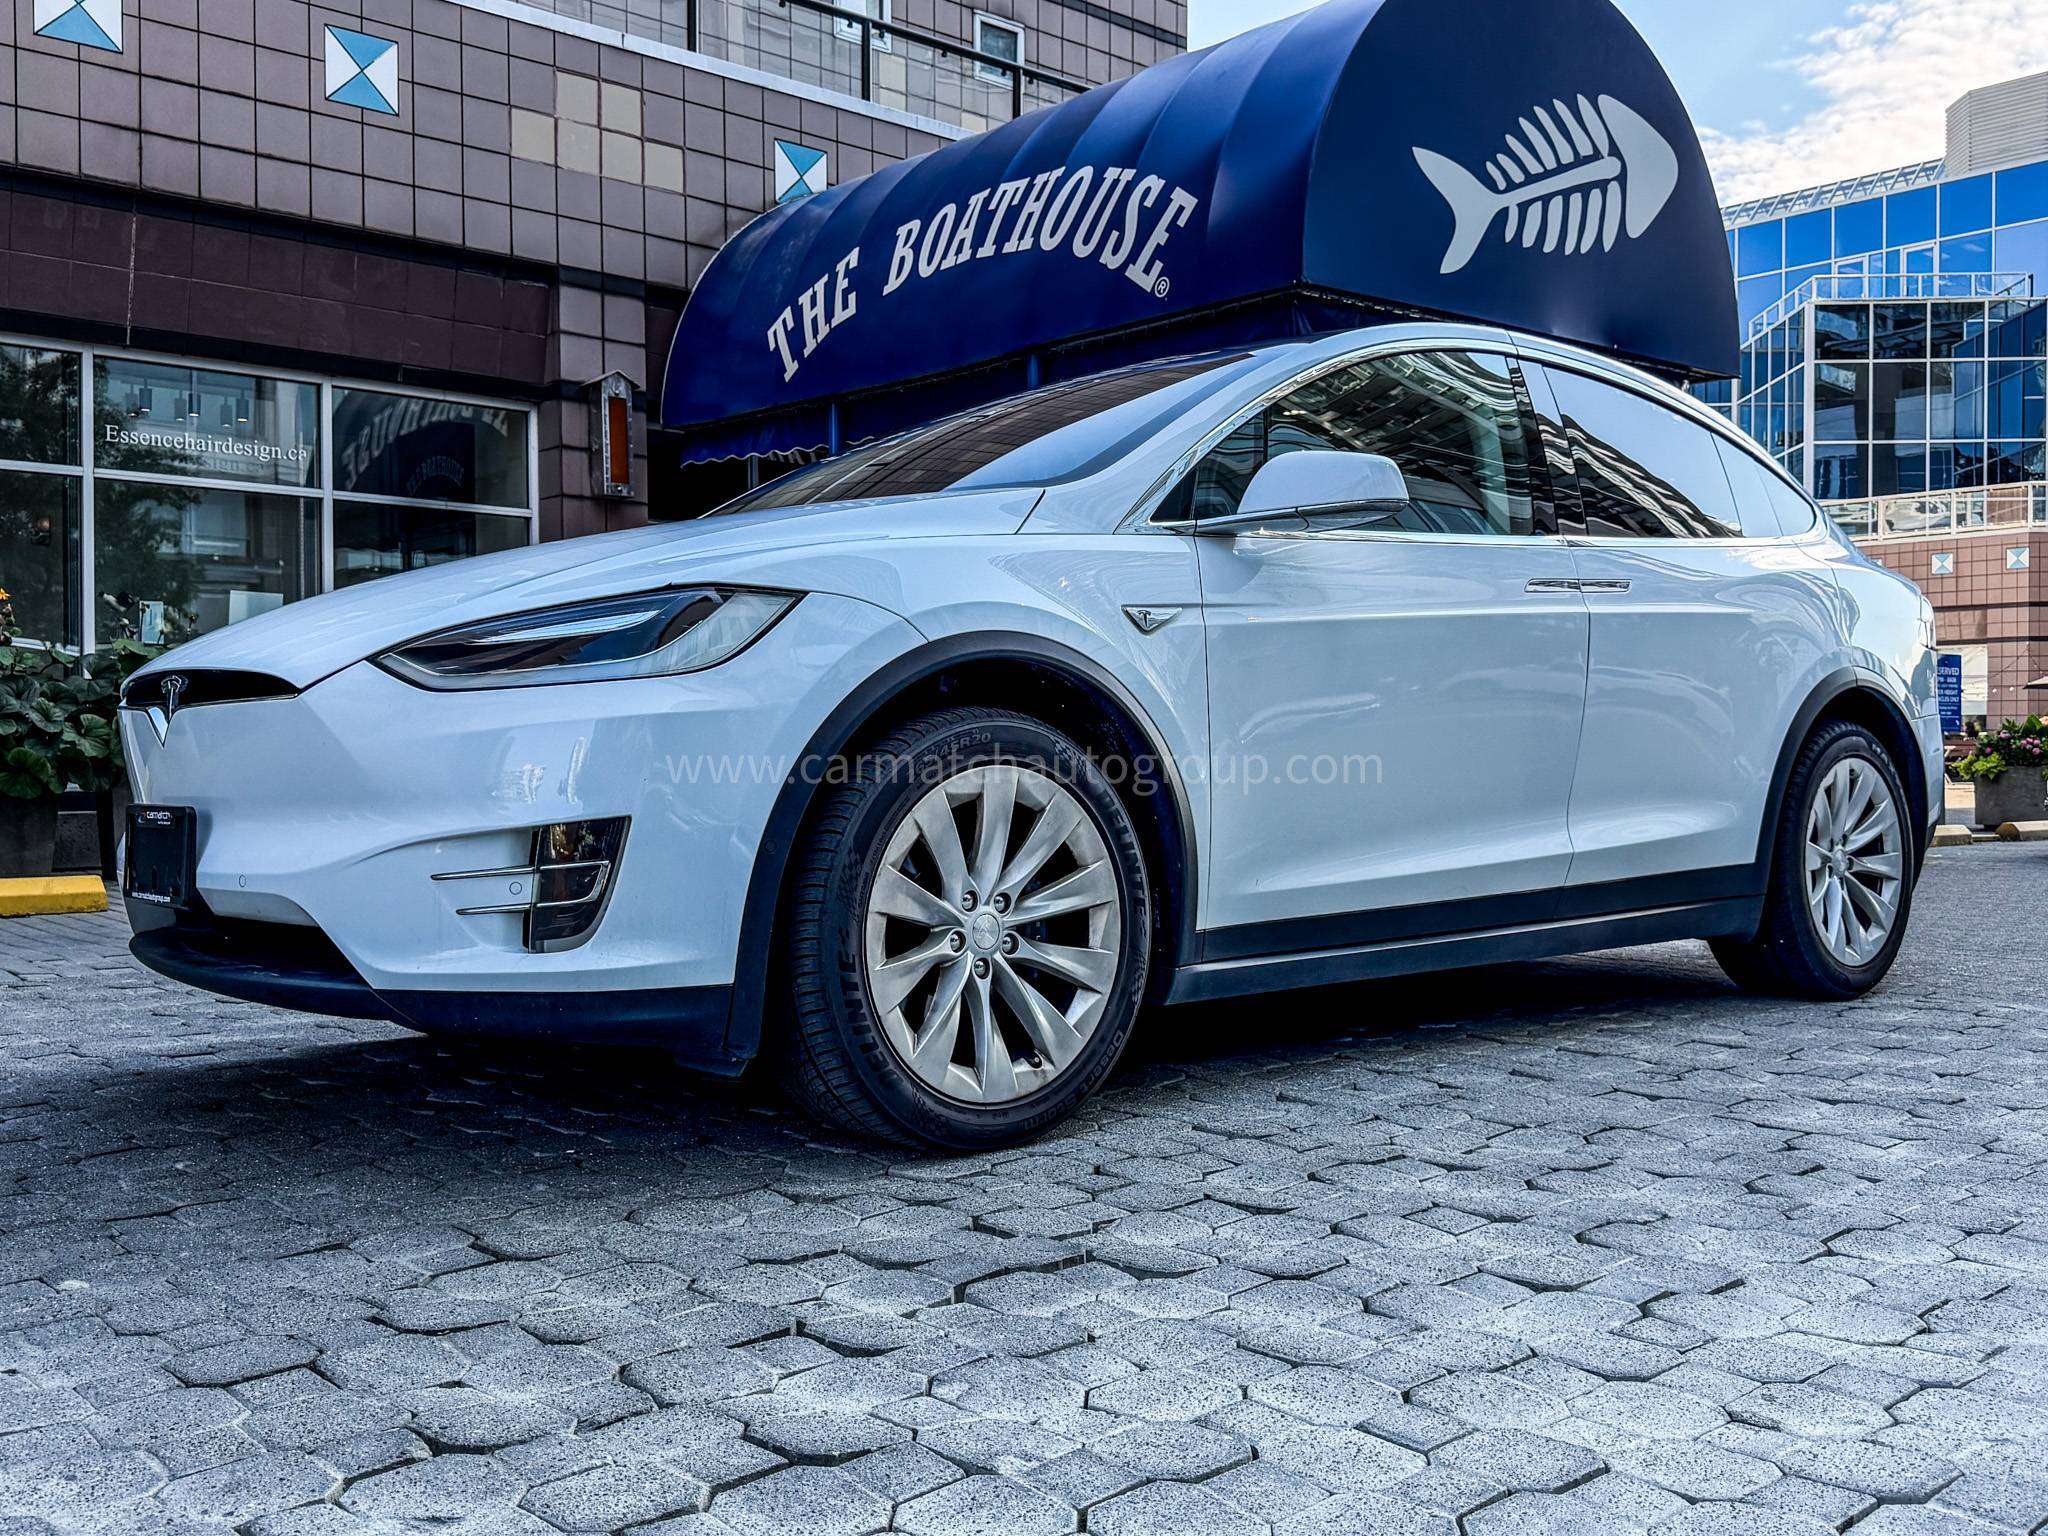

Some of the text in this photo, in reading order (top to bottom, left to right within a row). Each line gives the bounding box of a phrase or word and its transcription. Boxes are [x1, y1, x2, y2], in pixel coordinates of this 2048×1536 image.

[767, 247, 859, 383] THE
[105, 424, 307, 462] Essencehairdesign.ca
[1937, 666, 1960, 676] SERVED
